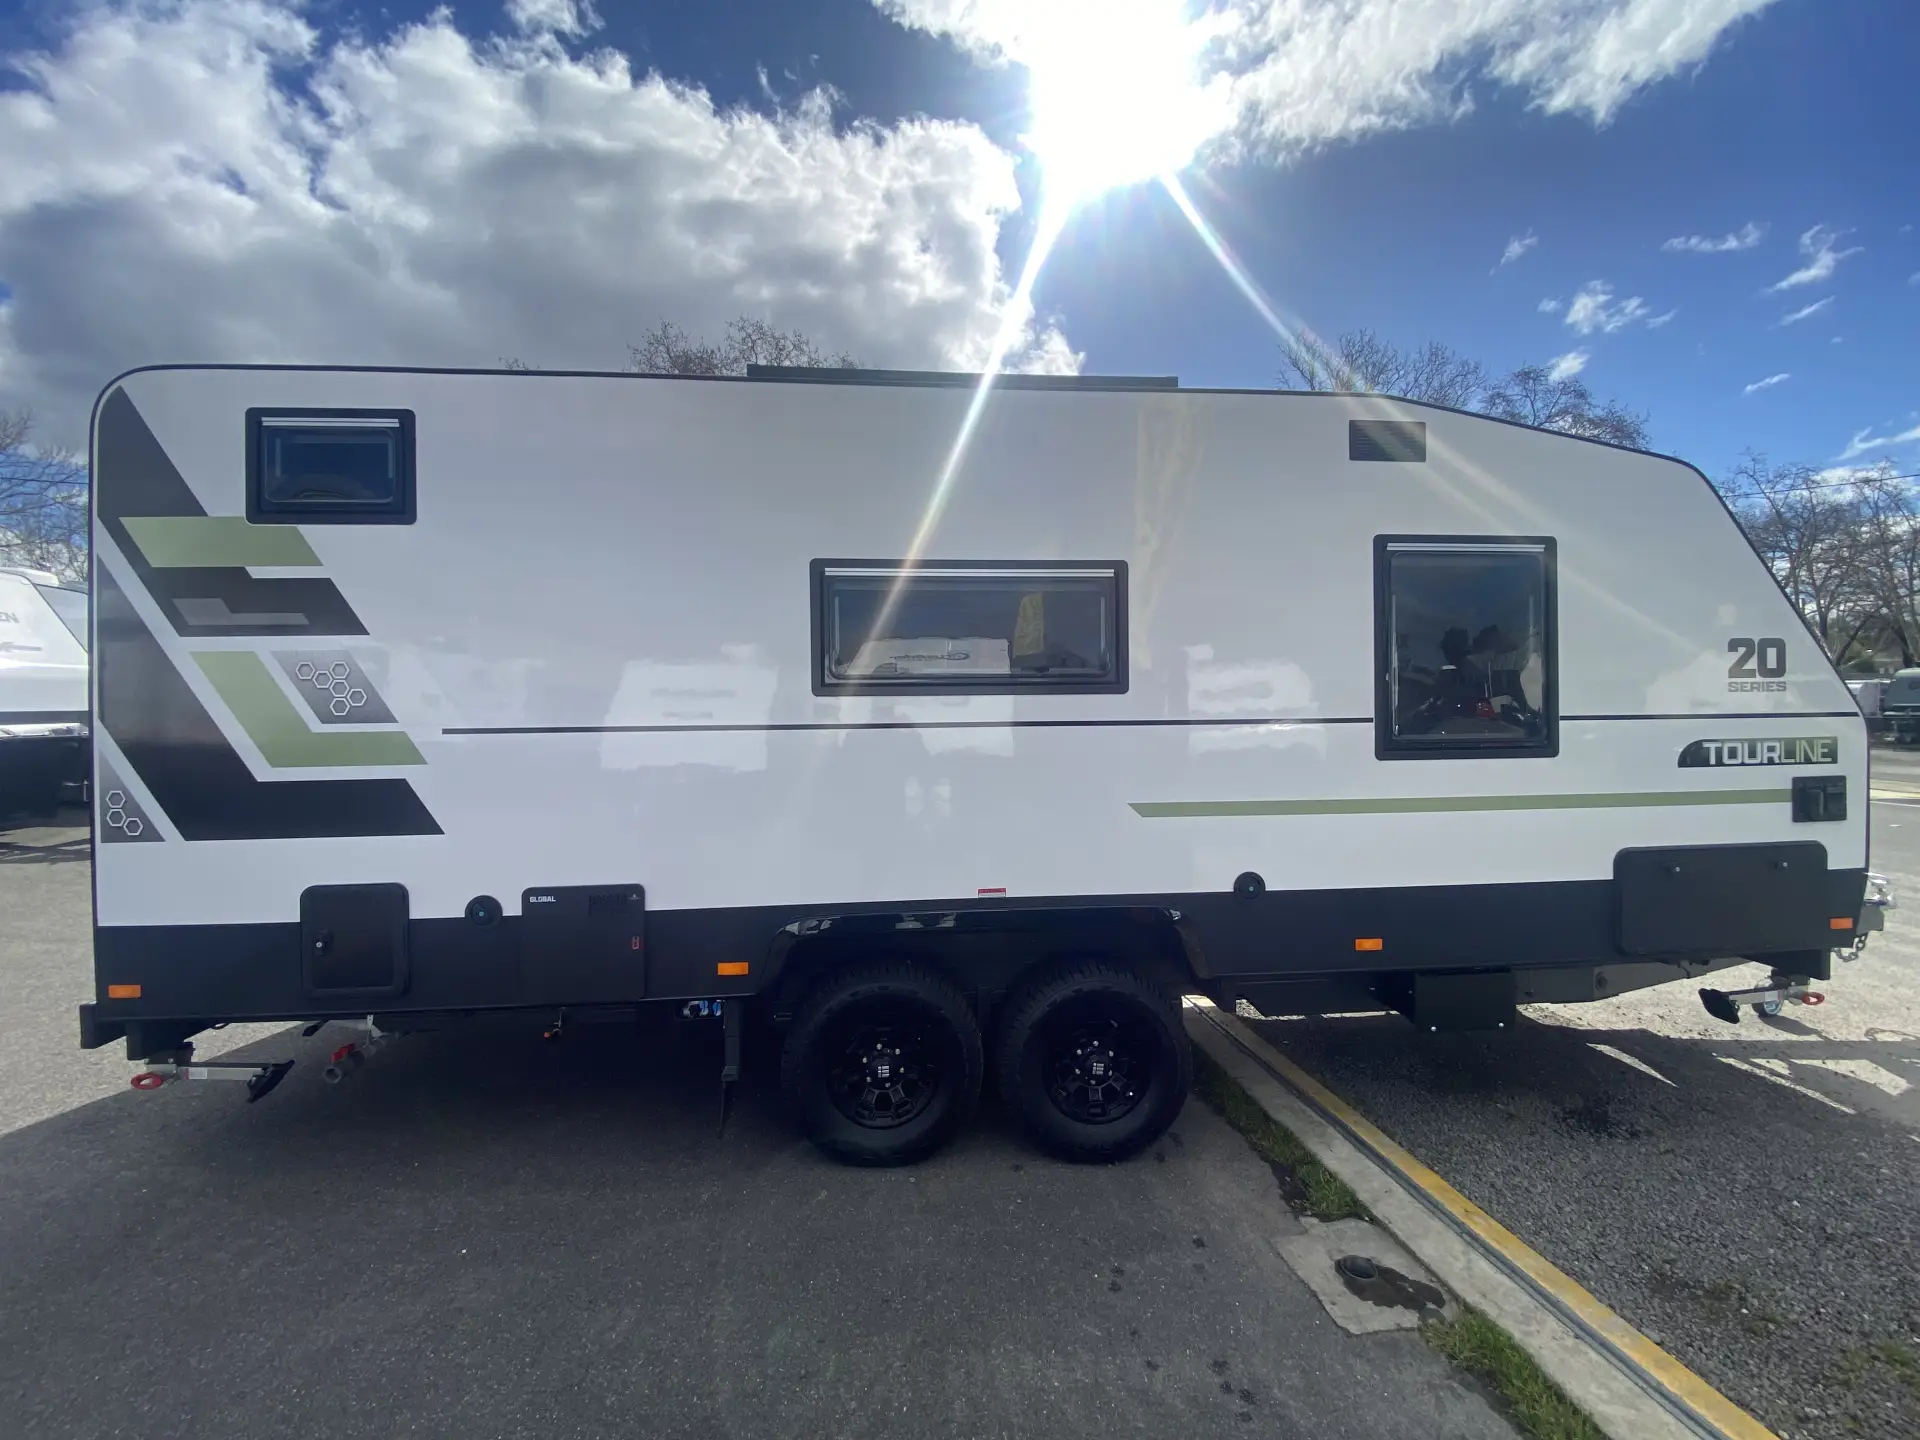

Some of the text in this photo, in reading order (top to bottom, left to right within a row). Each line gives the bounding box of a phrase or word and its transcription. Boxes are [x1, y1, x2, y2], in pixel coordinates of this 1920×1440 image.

[1727, 637, 1787, 679] 20
[1727, 681, 1787, 693] SERIES
[1702, 739, 1832, 765] TOURLINE
[529, 895, 557, 903] GLOBAL
